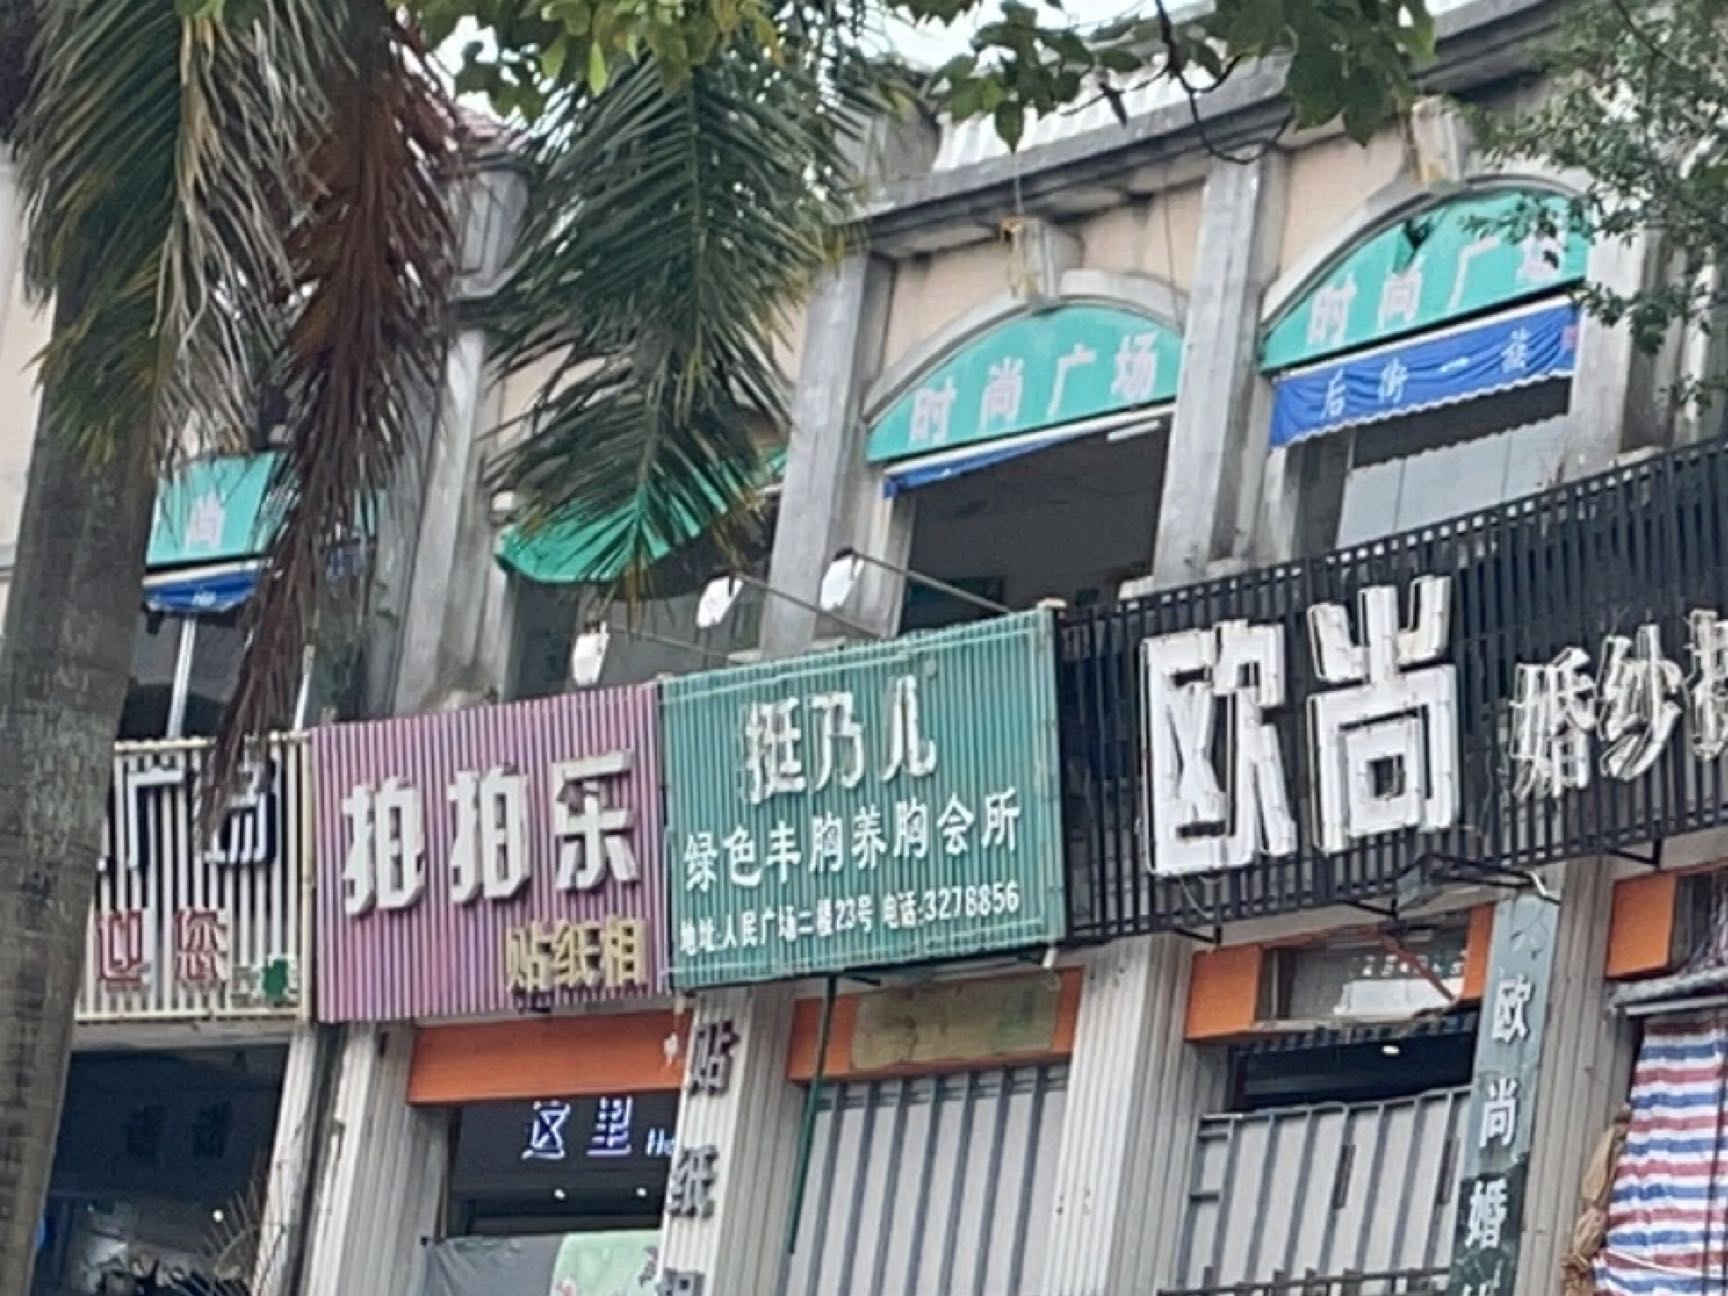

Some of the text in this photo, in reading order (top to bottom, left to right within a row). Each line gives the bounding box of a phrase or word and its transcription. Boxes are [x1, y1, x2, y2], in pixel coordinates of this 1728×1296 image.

[911, 331, 1159, 445] 时尚广场
[742, 674, 938, 806] 挺乃儿
[1141, 575, 1458, 874] 欧尚
[341, 750, 639, 918] 拍拍乐
[682, 785, 1021, 893] 绿色丰胸养胸会所
[507, 914, 648, 993] 贴纸相
